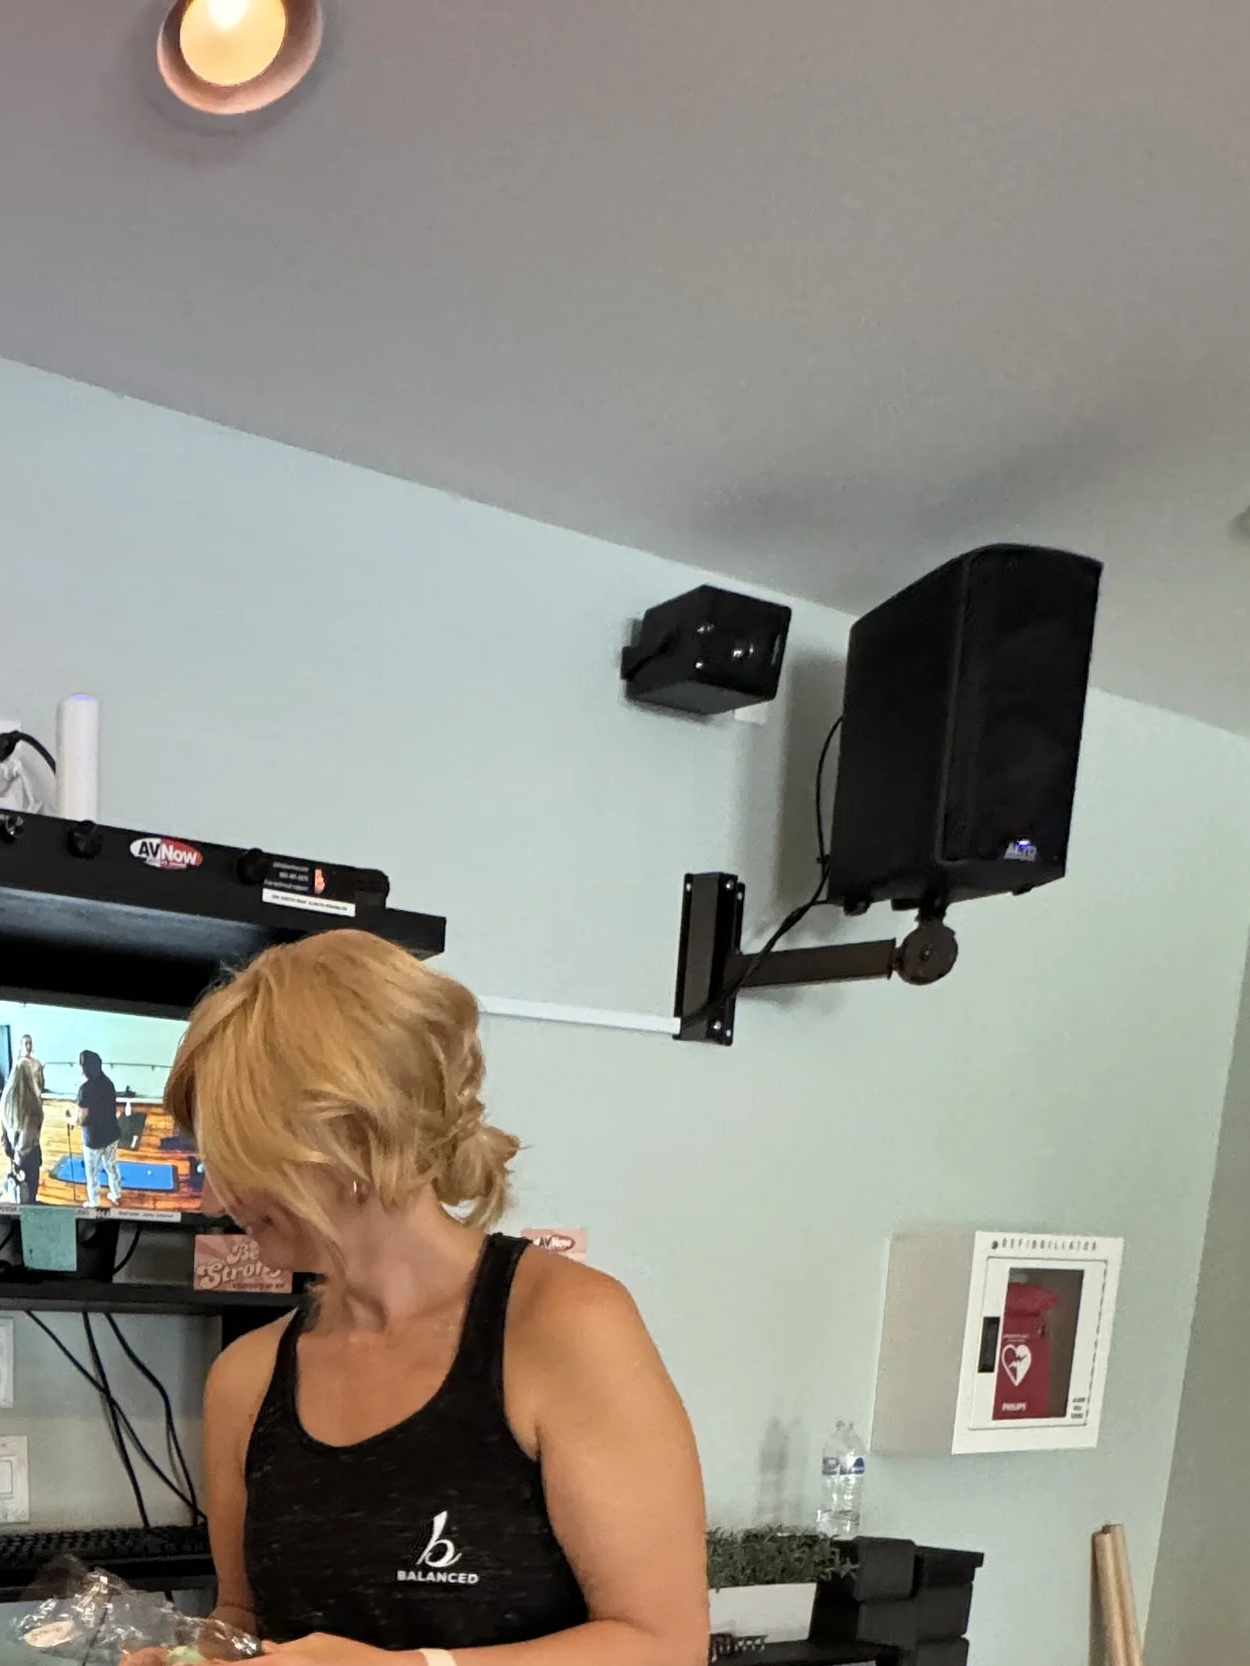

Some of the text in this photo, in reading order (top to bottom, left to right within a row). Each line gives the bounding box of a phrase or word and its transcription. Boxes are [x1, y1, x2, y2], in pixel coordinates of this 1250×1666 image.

[138, 840, 198, 866] AVNow
[227, 1242, 259, 1264] Be
[396, 1570, 480, 1585] BALANCED
